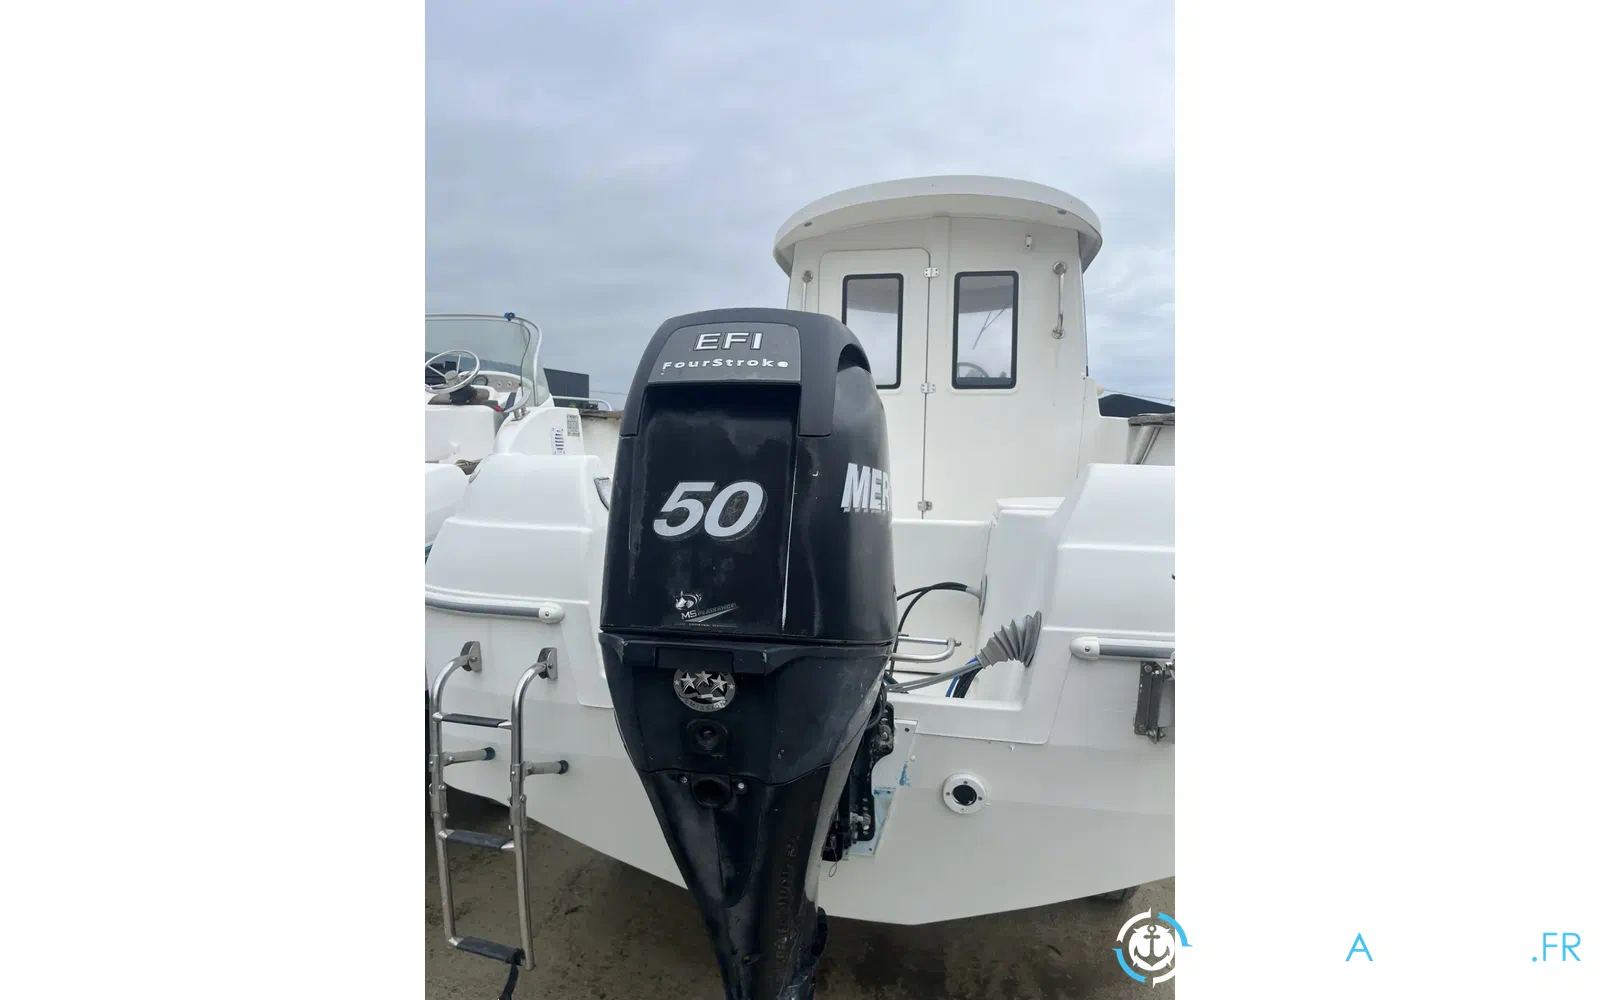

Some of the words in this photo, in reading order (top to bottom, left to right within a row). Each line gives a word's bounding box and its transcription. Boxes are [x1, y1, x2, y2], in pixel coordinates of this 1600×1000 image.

[693, 331, 764, 351] EFI
[662, 358, 788, 370] FourStroke
[653, 480, 765, 539] 50
